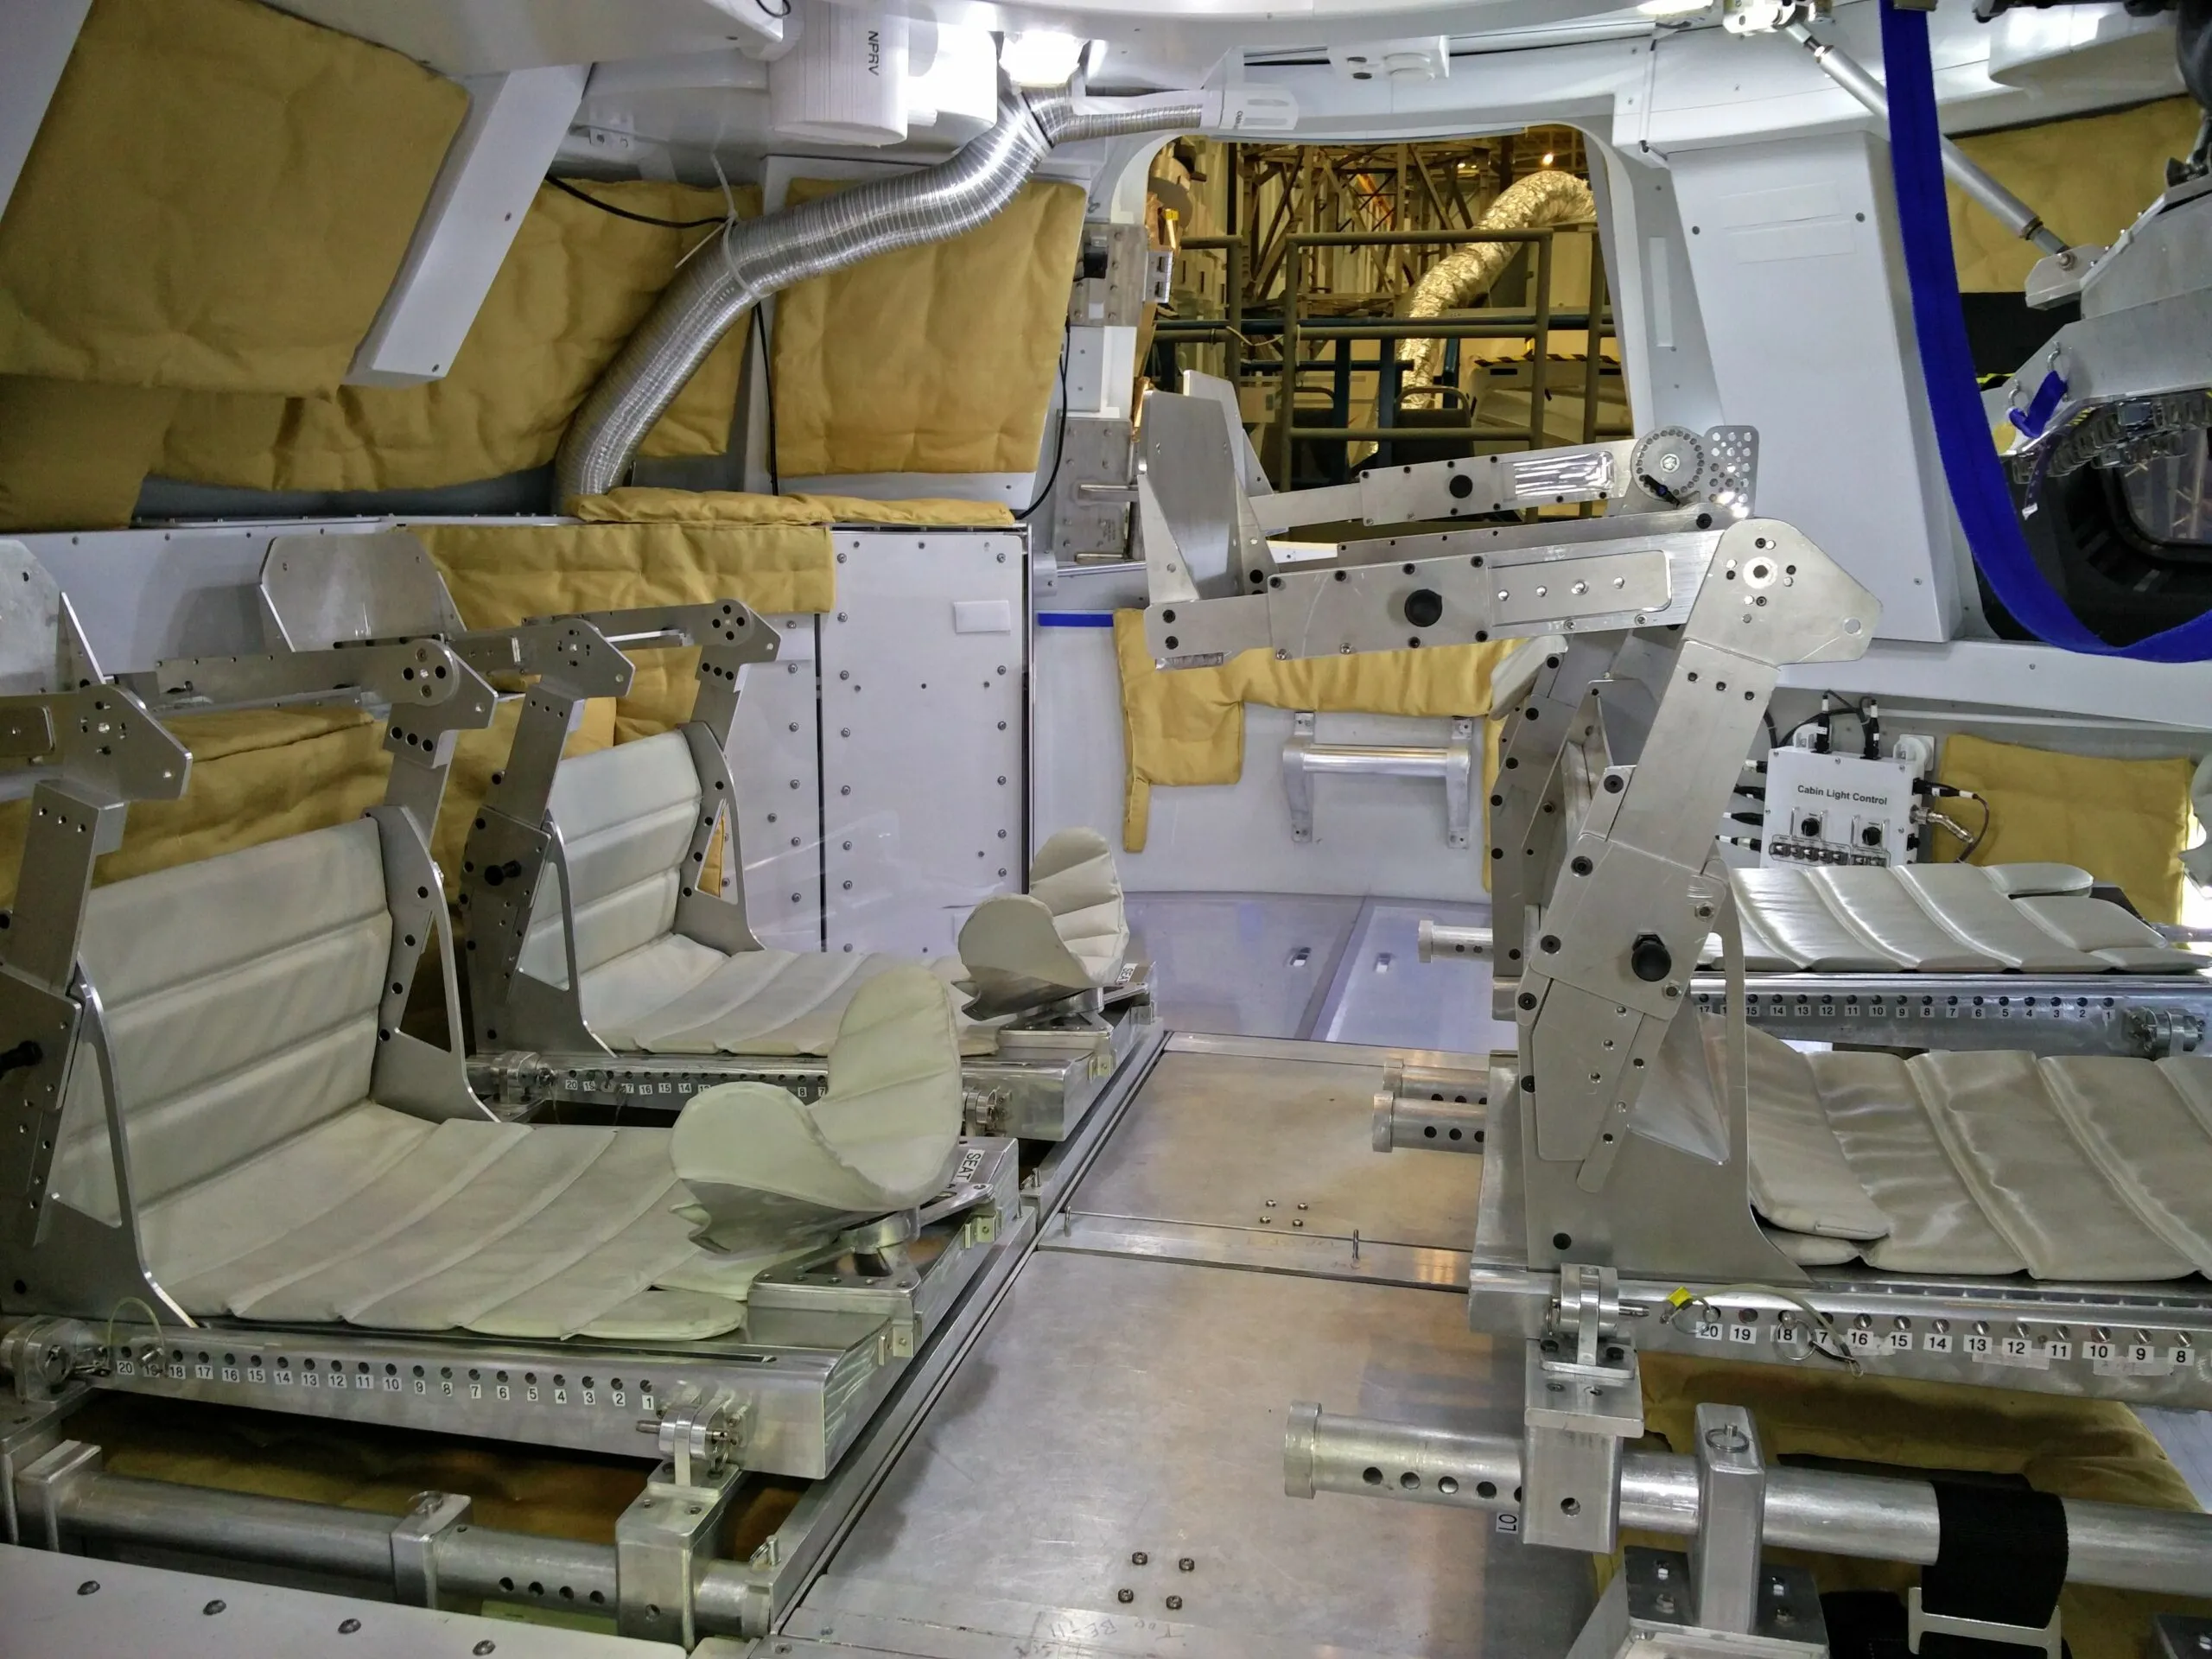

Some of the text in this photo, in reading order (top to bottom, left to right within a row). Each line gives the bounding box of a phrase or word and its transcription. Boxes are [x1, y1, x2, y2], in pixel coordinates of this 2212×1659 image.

[868, 30, 879, 76] NPRV
[1797, 785, 1887, 805] Cabin Light Control
[1898, 1008, 1905, 1017] 9
[660, 1084, 671, 1092] 15
[957, 1154, 981, 1179] SEAT
[1700, 1325, 1719, 1338] 20
[1734, 1328, 1751, 1340] 19
[1851, 1332, 1867, 1345] 16
[1891, 1335, 1908, 1347] 15
[1929, 1337, 1947, 1350] 14
[1969, 1338, 1986, 1351] 13
[2008, 1341, 2025, 1354] 12
[2051, 1344, 2067, 1357] 11
[2090, 1345, 2108, 1358] 10
[2136, 1348, 2146, 1360] 9
[2176, 1351, 2186, 1363] 8
[119, 1362, 132, 1374] 20
[171, 1366, 183, 1377] 18
[198, 1367, 211, 1377] 17
[224, 1370, 238, 1381] 16
[250, 1370, 263, 1381] 15
[276, 1372, 289, 1382] 14
[303, 1375, 316, 1386] 13
[330, 1376, 344, 1387] 12
[358, 1376, 370, 1388] 11
[386, 1379, 399, 1390] 10
[416, 1382, 423, 1392] 9
[443, 1383, 451, 1395] 8
[471, 1386, 479, 1396] 7
[499, 1388, 507, 1398] 6
[530, 1389, 537, 1399] 5
[557, 1391, 565, 1402] 4
[586, 1392, 593, 1403] 3
[616, 1393, 624, 1405] 2
[646, 1397, 652, 1408] 1
